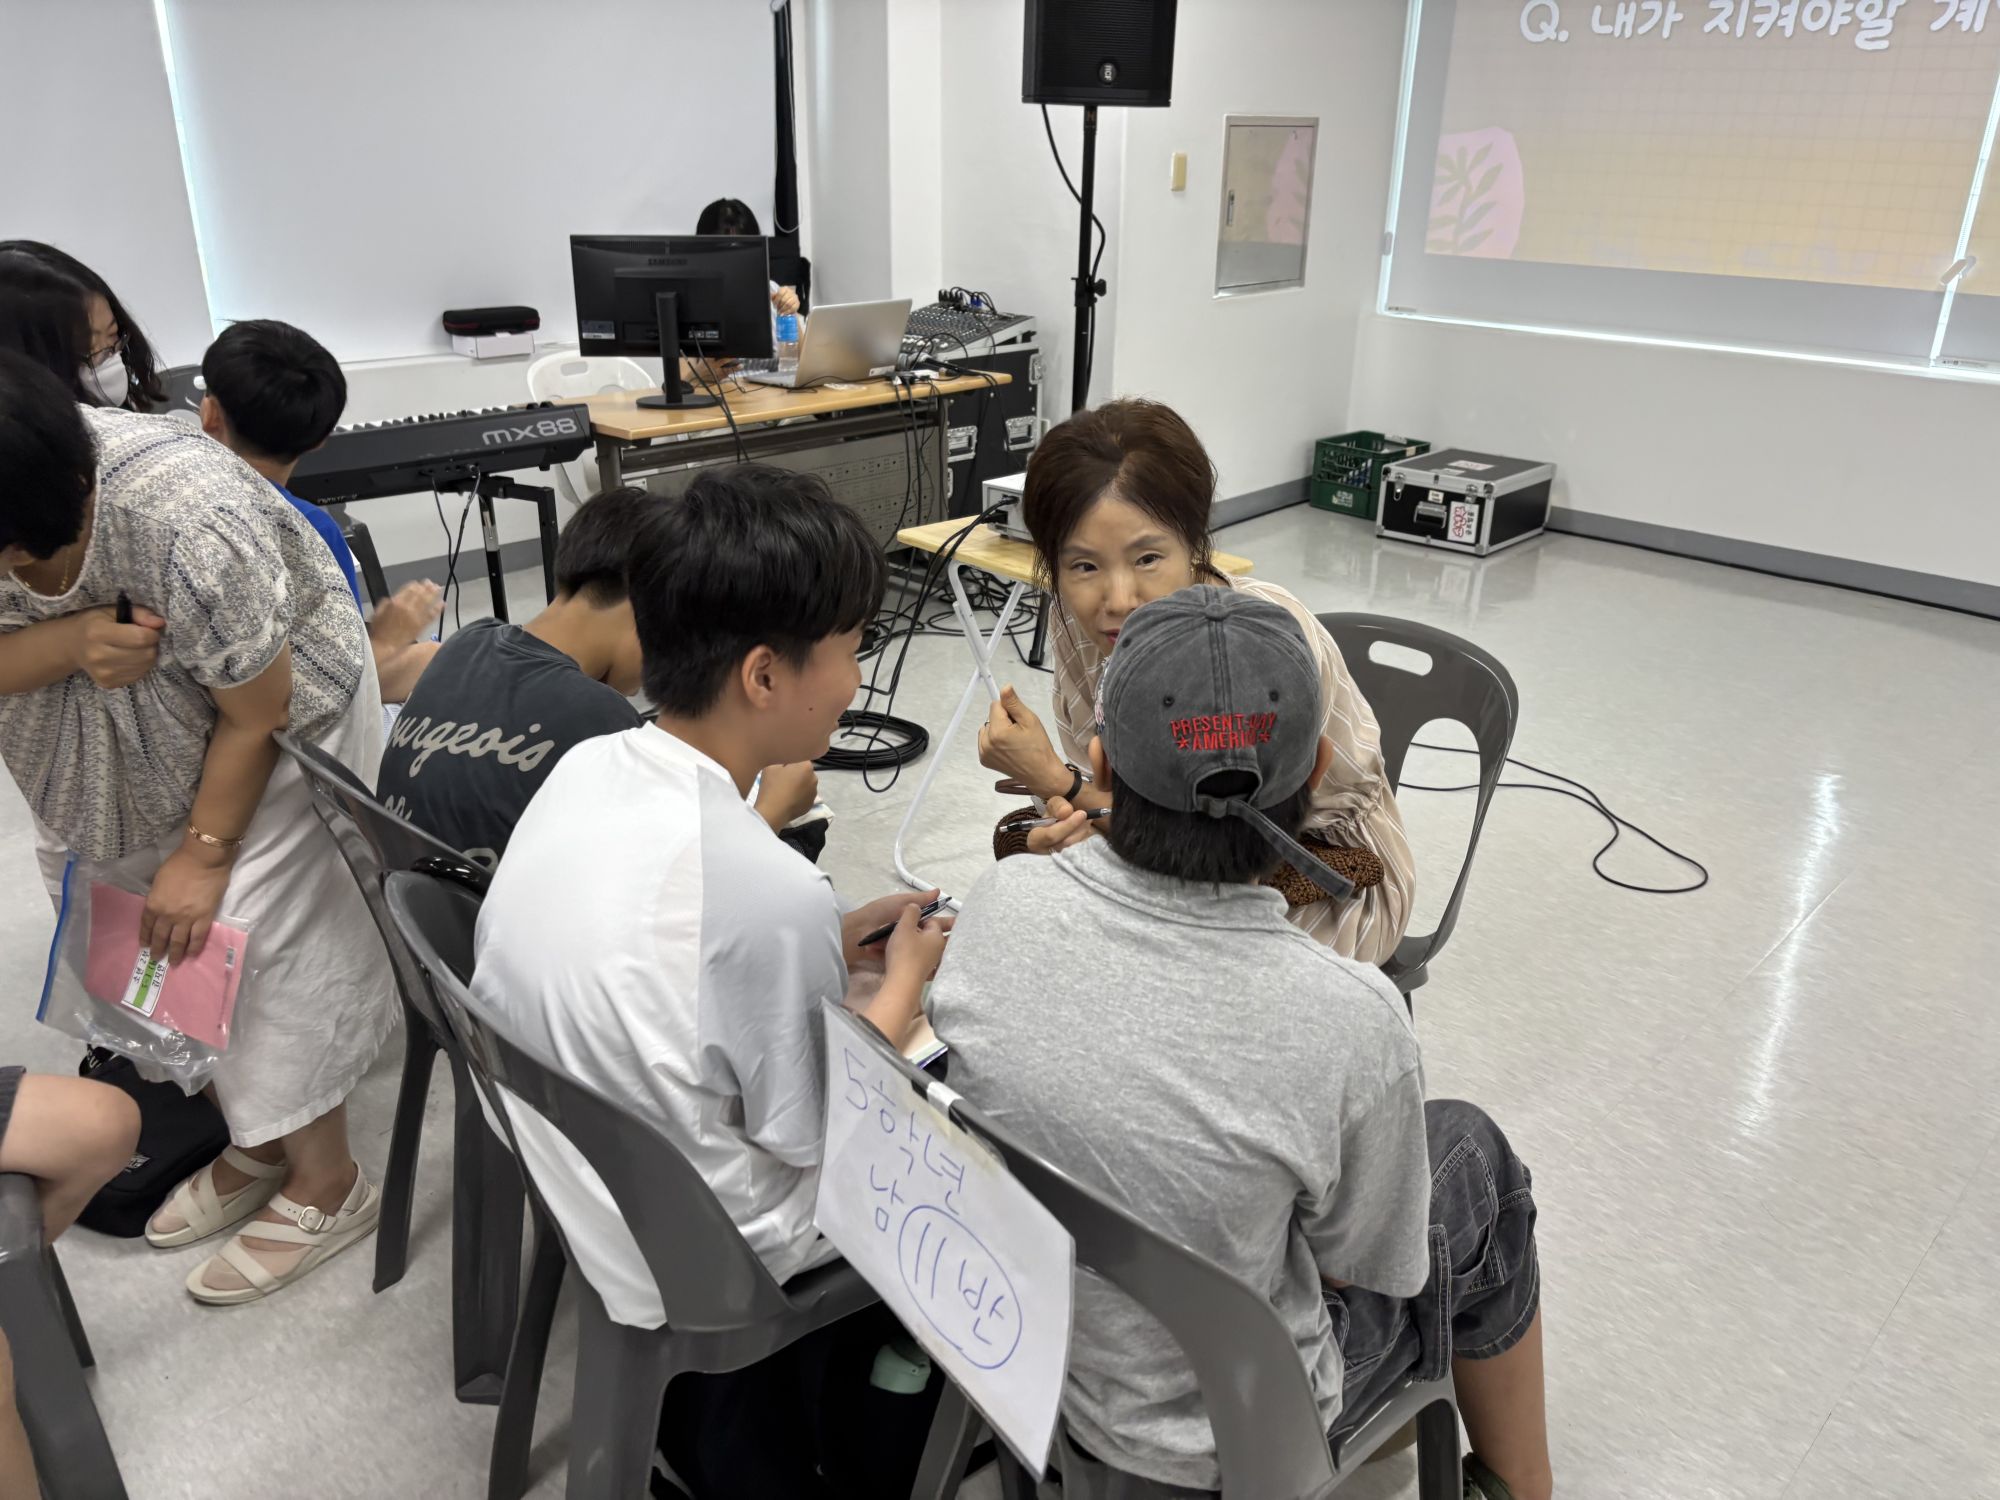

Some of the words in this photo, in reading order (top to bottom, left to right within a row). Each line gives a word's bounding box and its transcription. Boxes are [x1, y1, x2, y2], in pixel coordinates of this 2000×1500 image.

[1520, 0, 1569, 43] Q.
[1591, 0, 1684, 39] 내가
[844, 1047, 965, 1216] 5학년
[870, 1163, 904, 1232] 남
